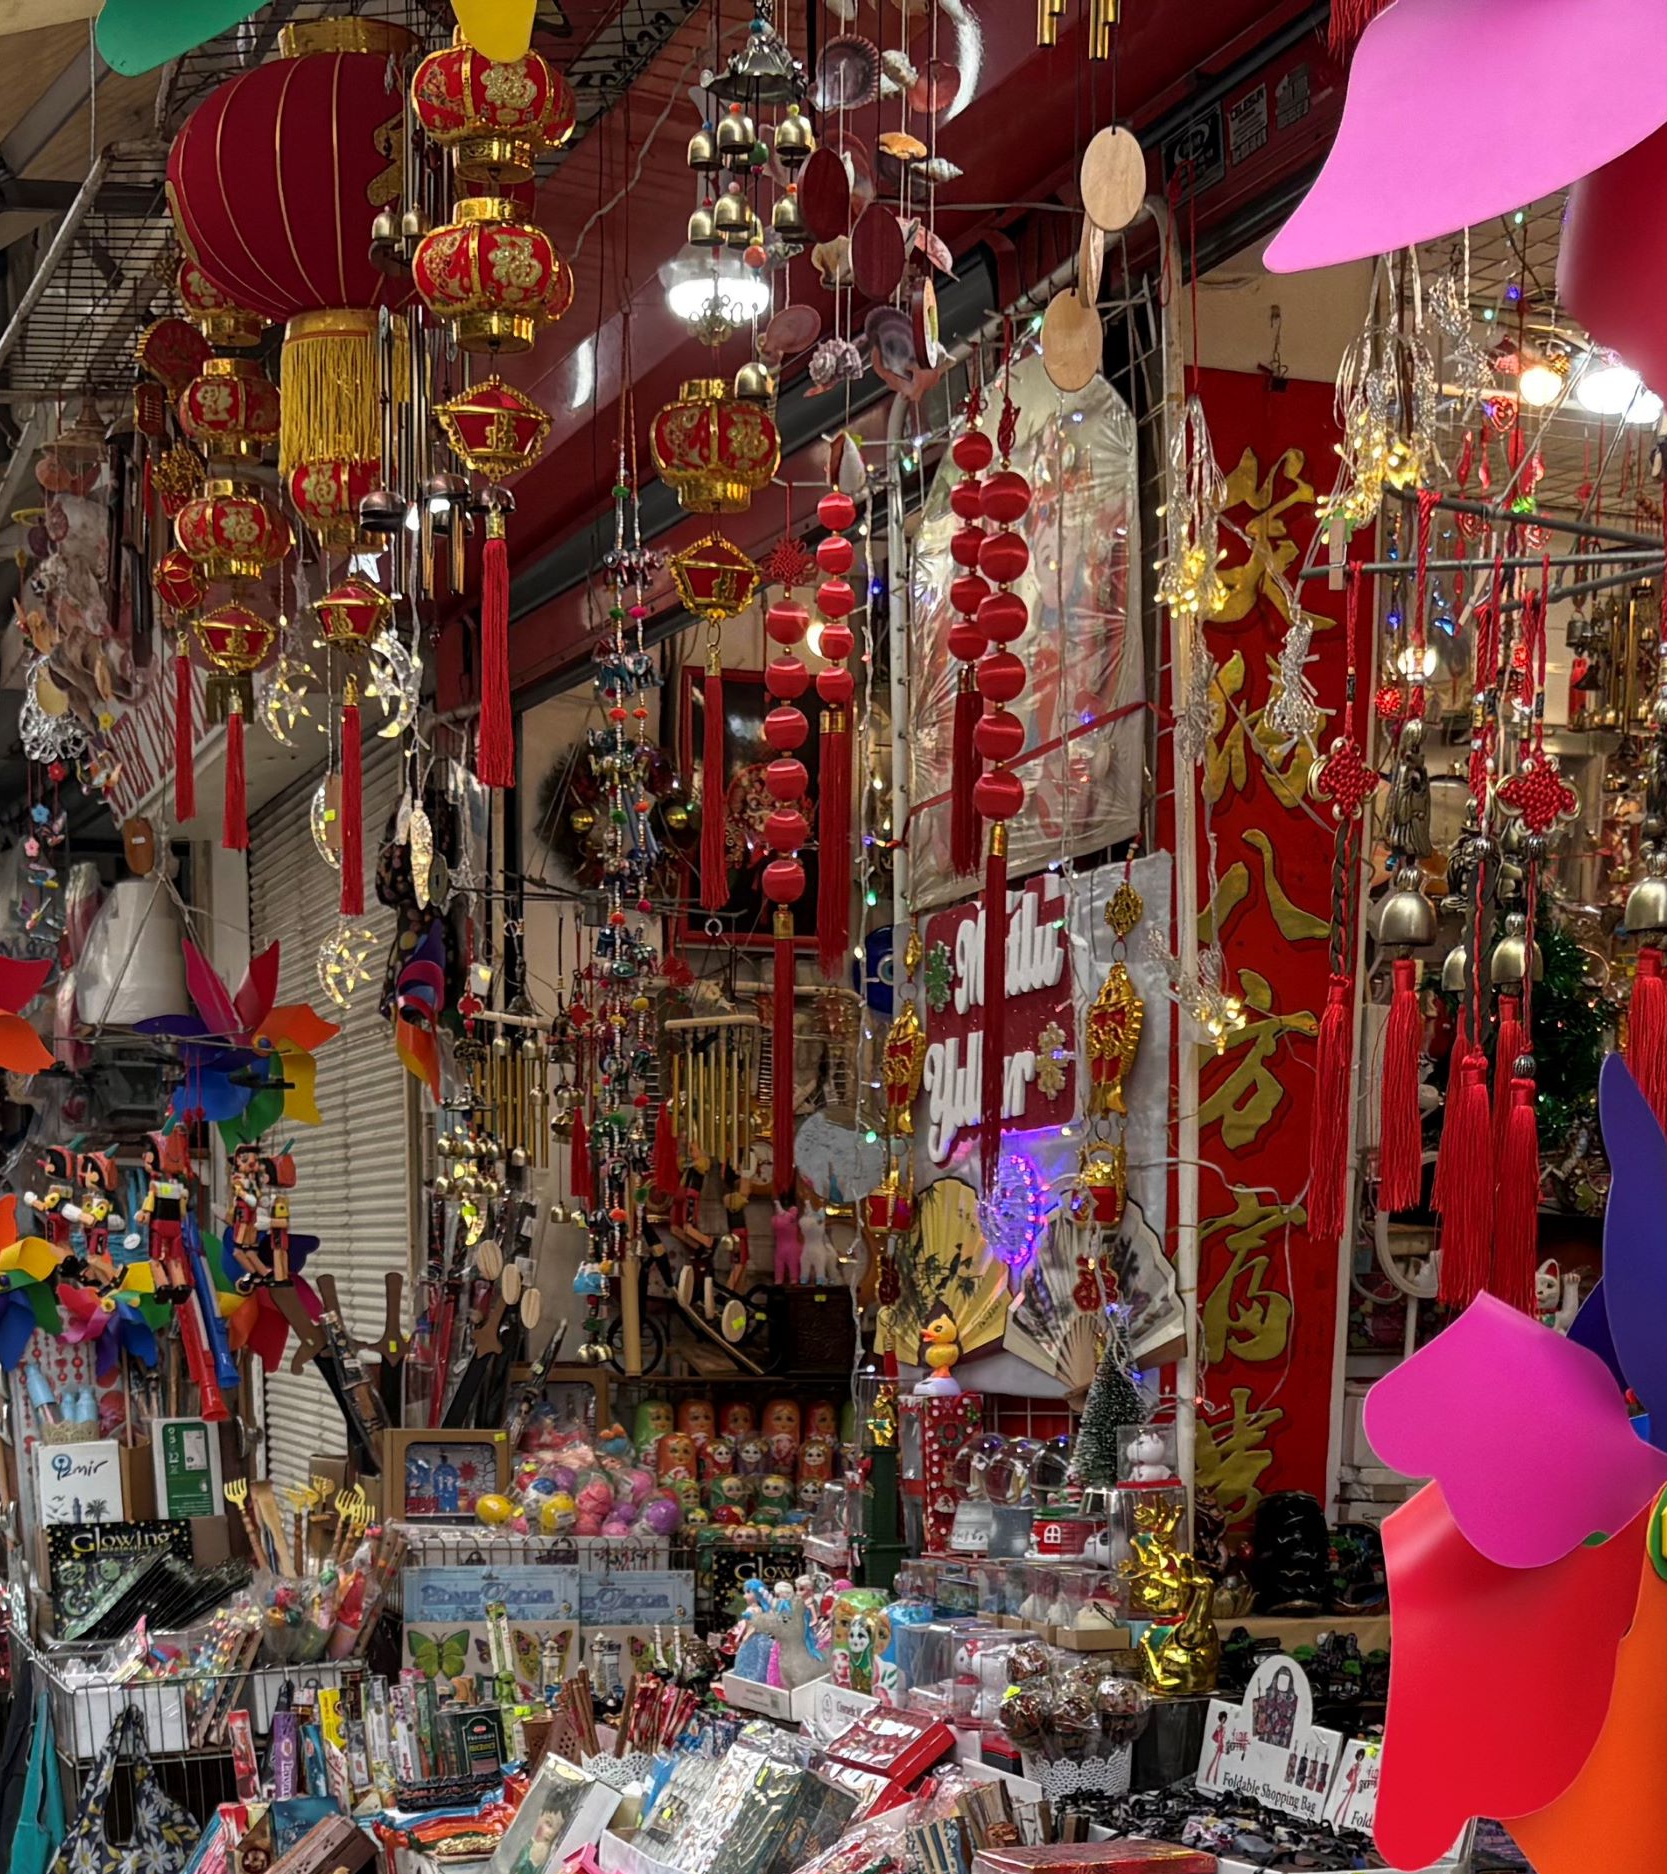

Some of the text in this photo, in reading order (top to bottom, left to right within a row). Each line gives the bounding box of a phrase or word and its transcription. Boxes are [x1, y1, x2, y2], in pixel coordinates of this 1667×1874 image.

[1222, 1772, 1317, 1818] Foldable Shopping Bag
